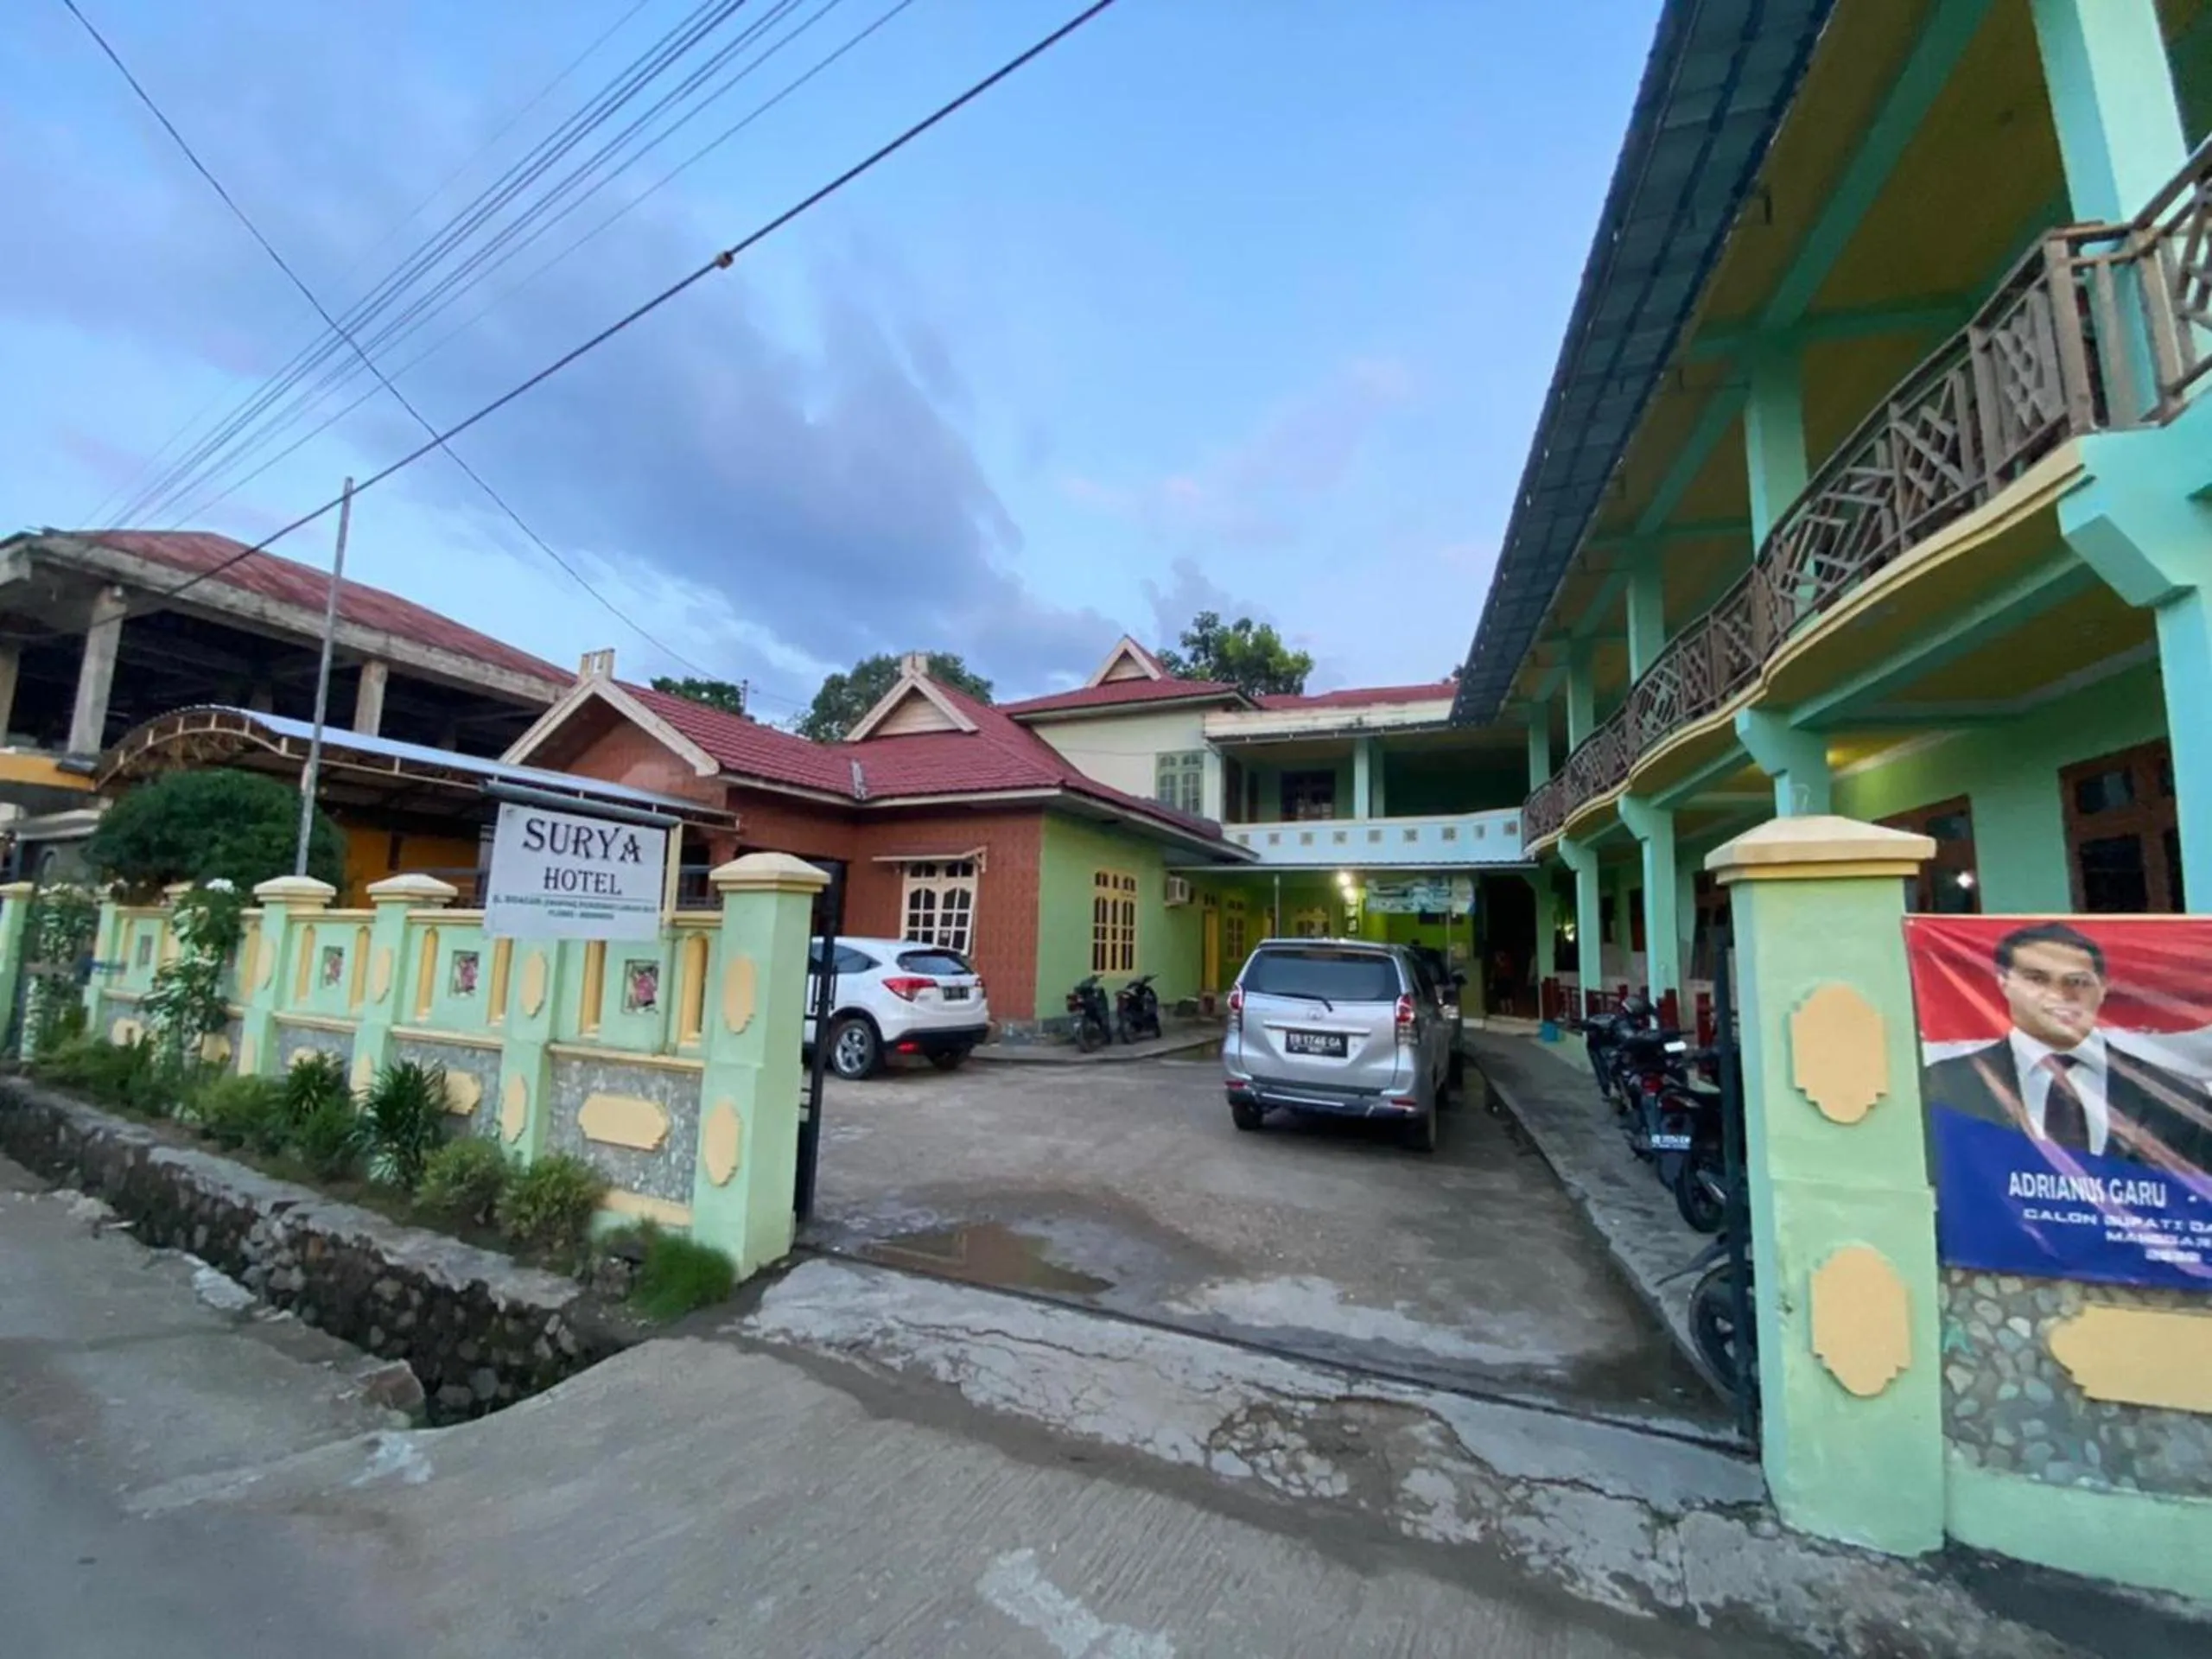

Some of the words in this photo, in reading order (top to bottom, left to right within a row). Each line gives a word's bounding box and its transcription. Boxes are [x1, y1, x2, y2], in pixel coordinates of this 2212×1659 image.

[522, 817, 641, 864] SURYA
[543, 867, 622, 895] HOTEL
[2008, 1172, 2104, 1203] ADRIANUS
[2107, 1178, 2166, 1208] GARU
[2023, 1207, 2097, 1225] CALON
